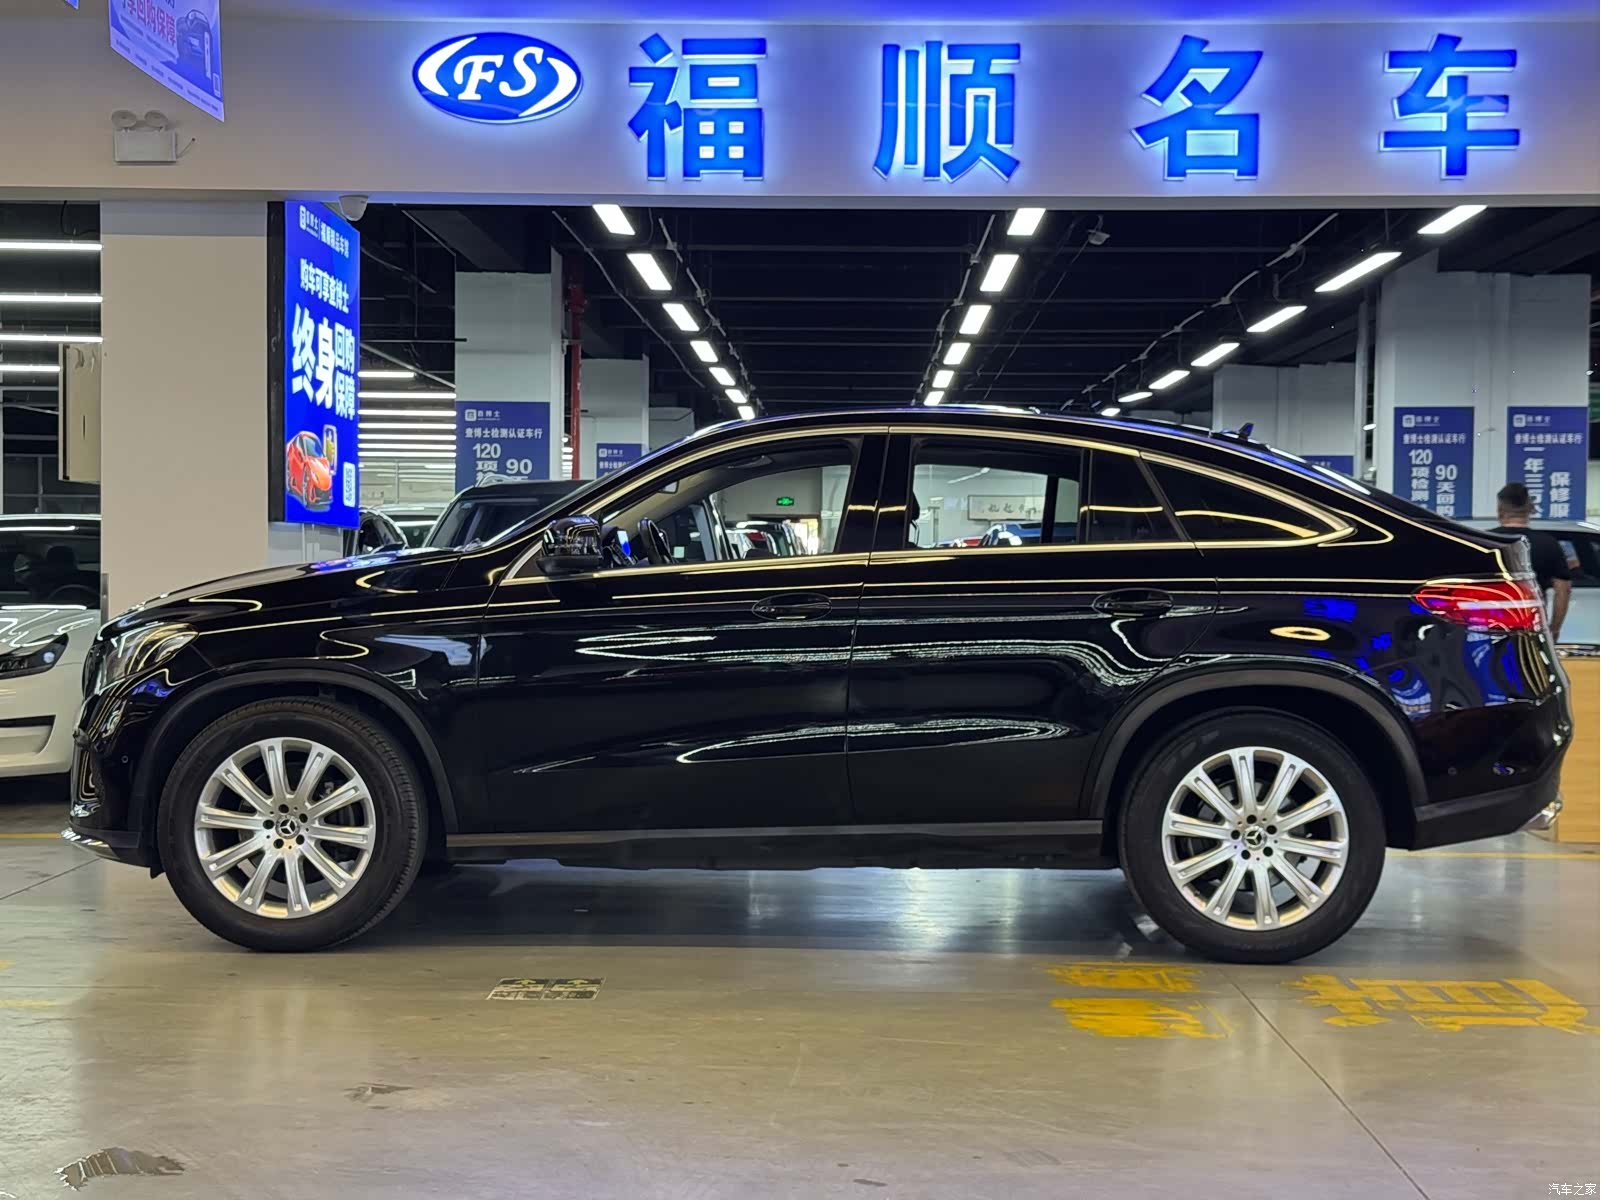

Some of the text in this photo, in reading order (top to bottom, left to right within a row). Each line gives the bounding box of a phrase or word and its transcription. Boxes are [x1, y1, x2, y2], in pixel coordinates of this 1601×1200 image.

[453, 45, 545, 101] FS
[628, 33, 1521, 181] 福顺名车
[300, 257, 350, 314] 购车可享查博士
[291, 302, 335, 410] 终身
[334, 321, 355, 374] 回购
[334, 369, 355, 421] 保障
[465, 427, 543, 439] 查博士检测认证车行
[472, 443, 502, 459] 120
[1408, 449, 1433, 465] 120
[505, 458, 533, 475] 90
[1435, 464, 1458, 481] 90
